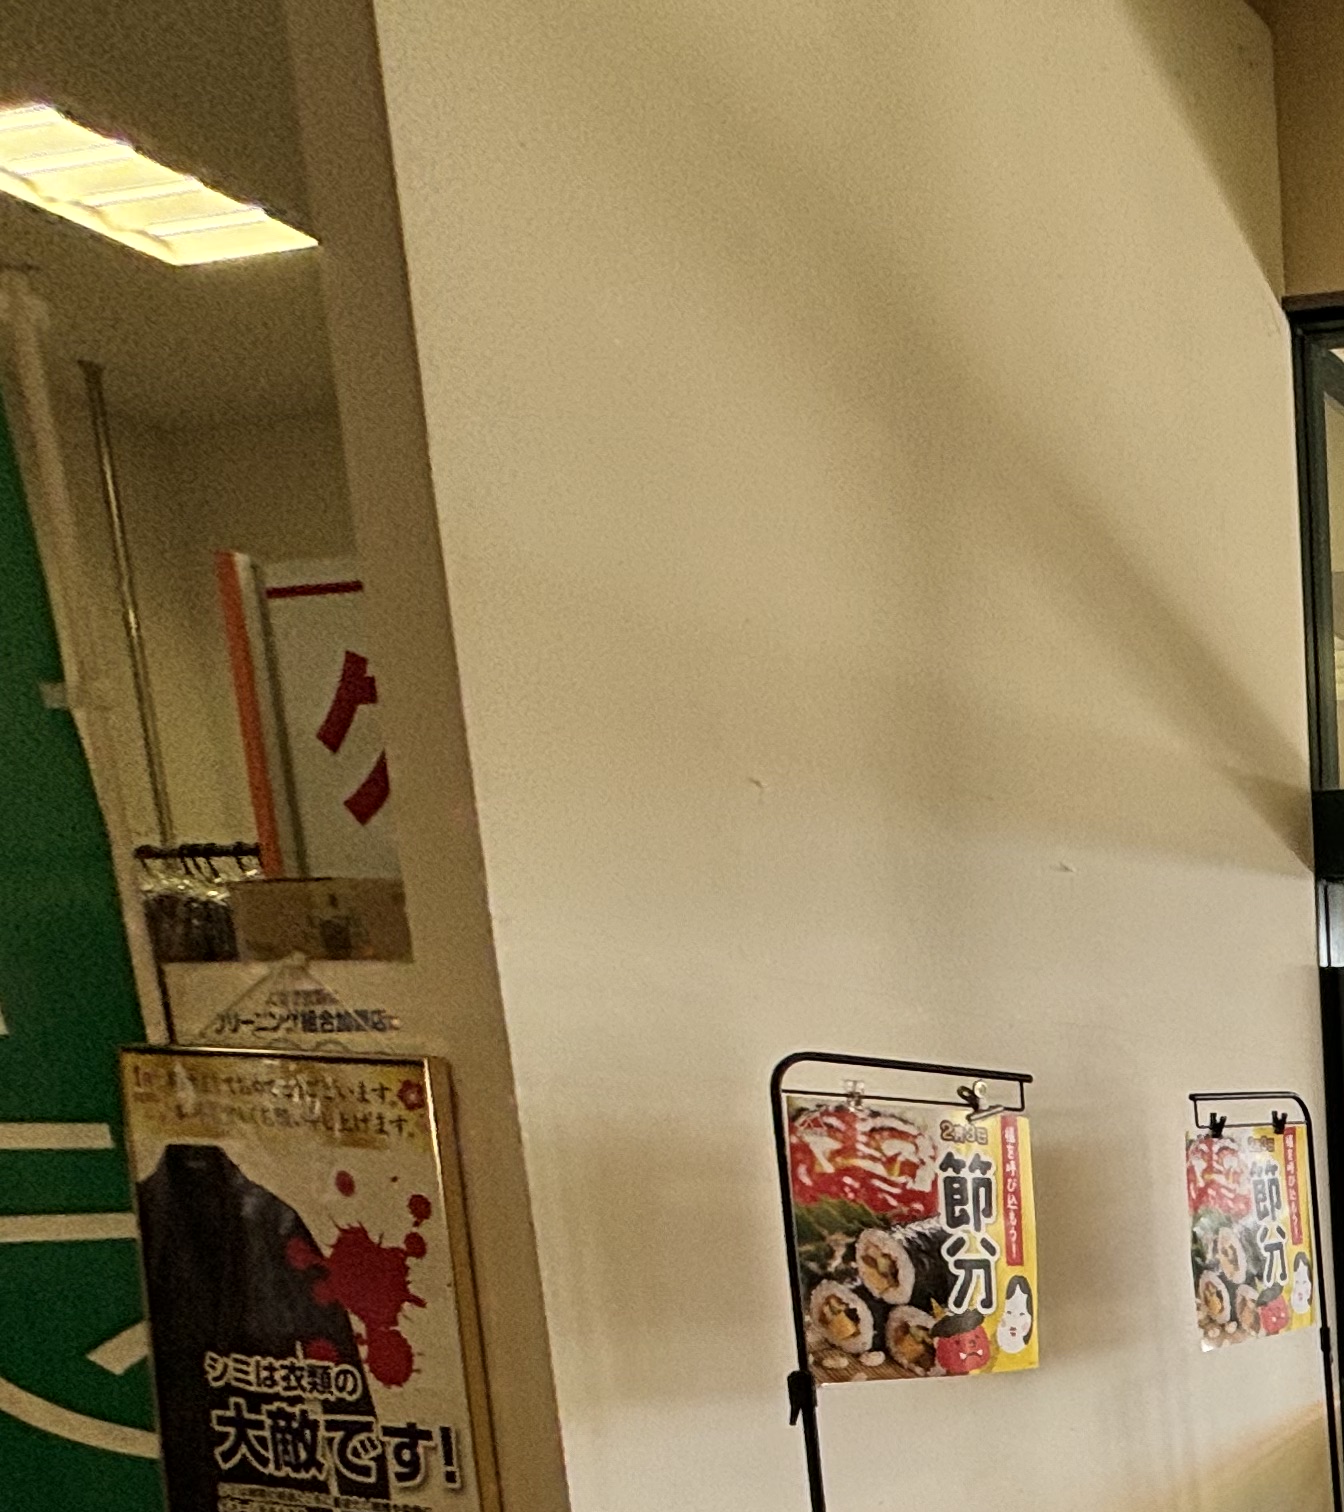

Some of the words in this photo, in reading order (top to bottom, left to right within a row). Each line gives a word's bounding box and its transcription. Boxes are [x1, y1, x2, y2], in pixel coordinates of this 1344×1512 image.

[939, 1151, 997, 1309] 節分
[1250, 1160, 1288, 1286] 節分
[204, 1351, 362, 1400] シミは衣類の
[211, 1397, 460, 1490] 大敵です!
